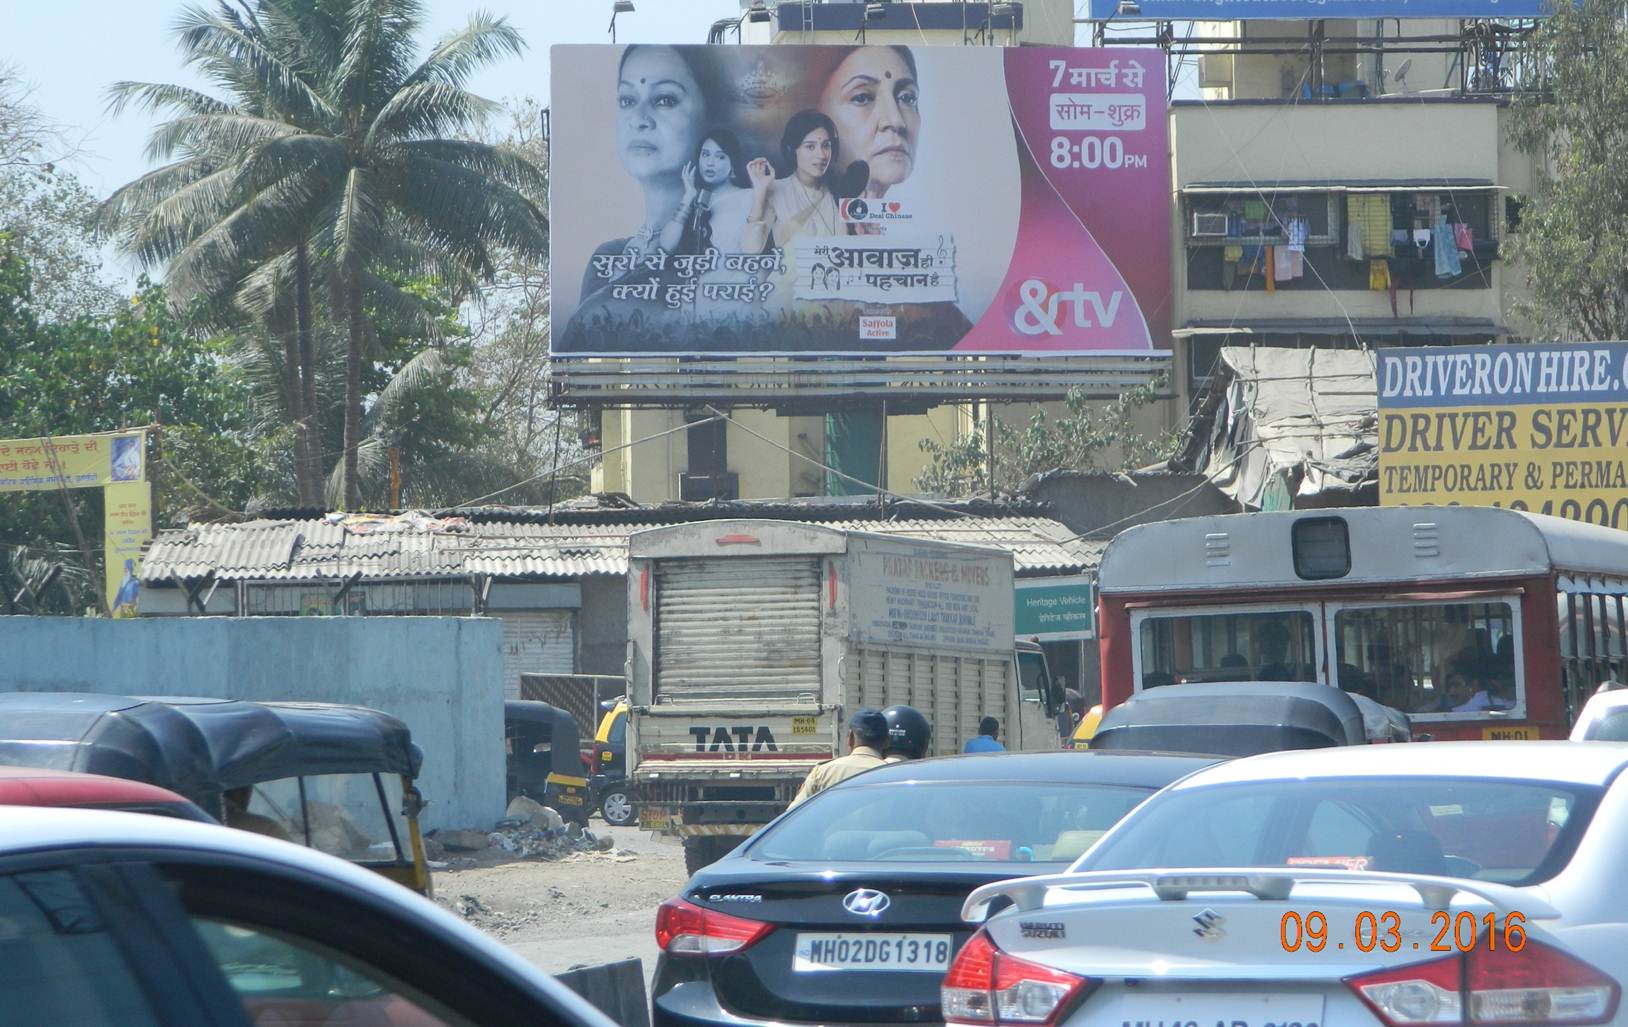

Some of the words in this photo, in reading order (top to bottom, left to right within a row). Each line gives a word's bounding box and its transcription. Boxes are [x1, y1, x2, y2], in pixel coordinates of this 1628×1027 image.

[1049, 60, 1066, 87] 7
[1069, 60, 1119, 87] मार्च
[1121, 60, 1146, 87] से
[593, 248, 640, 277] सुरों
[644, 248, 669, 271] से
[674, 247, 719, 277] जुड़ी
[828, 246, 921, 270] आवाज़
[921, 255, 933, 268] ही
[612, 278, 660, 300] क्यों
[665, 279, 697, 307] हुई
[866, 273, 929, 291] पहचान
[930, 272, 940, 286] है
[1382, 350, 1628, 397] DRIVERONHIRE.
[1382, 411, 1518, 452] DRIVER
[1530, 407, 1628, 449] SERV
[1384, 462, 1519, 493] TEMPORARY
[1524, 461, 1544, 490] &
[1026, 597, 1058, 607] Heritage
[1060, 595, 1086, 605] Vehicle
[689, 726, 778, 752] TATA
[810, 939, 948, 964] MH02DG1318
